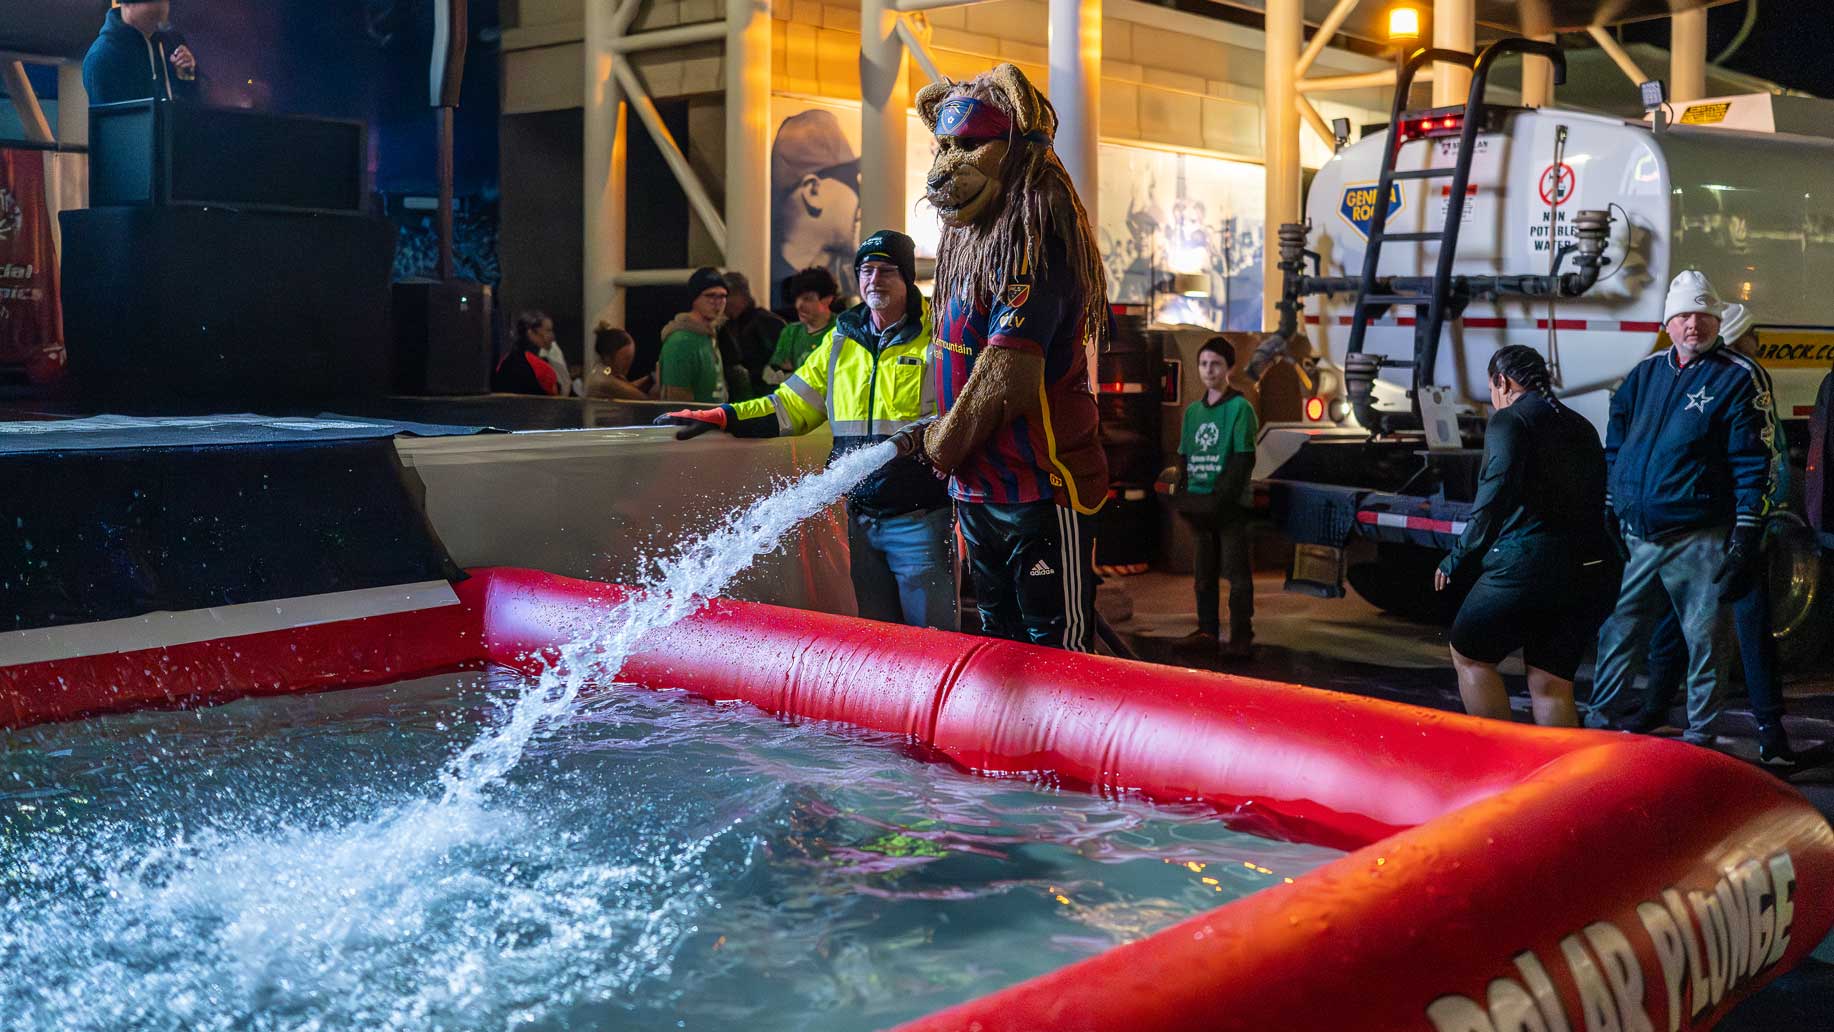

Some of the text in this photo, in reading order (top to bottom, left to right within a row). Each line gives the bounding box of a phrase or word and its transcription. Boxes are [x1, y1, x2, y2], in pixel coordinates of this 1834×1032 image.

[1346, 187, 1396, 206] GENA
[1543, 211, 1565, 222] NN
[1530, 226, 1577, 237] POTBLE
[1534, 240, 1571, 250] WAER
[1636, 850, 1796, 1032] PLUNGE
